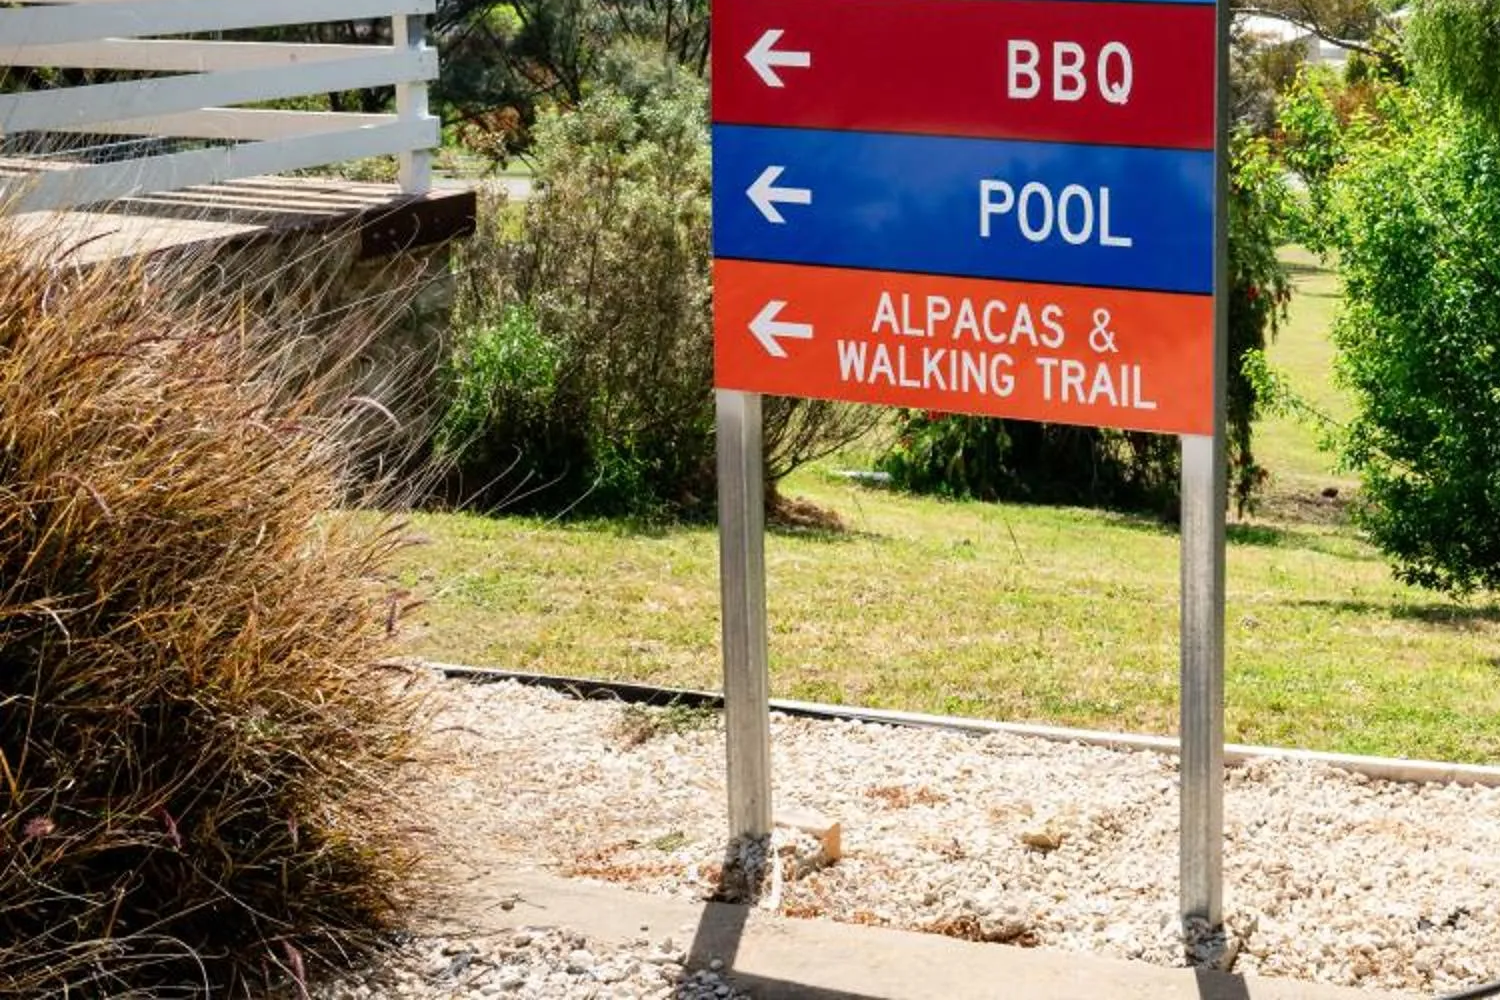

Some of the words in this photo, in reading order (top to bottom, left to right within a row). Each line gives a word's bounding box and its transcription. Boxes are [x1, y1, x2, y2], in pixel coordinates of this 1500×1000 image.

[1007, 39, 1133, 105] BBQ
[979, 179, 1133, 248] POOL
[871, 291, 1065, 349] ALPACAS
[1089, 308, 1119, 353] &
[837, 340, 1016, 398] WALKING
[1036, 356, 1158, 410] TRAIL
